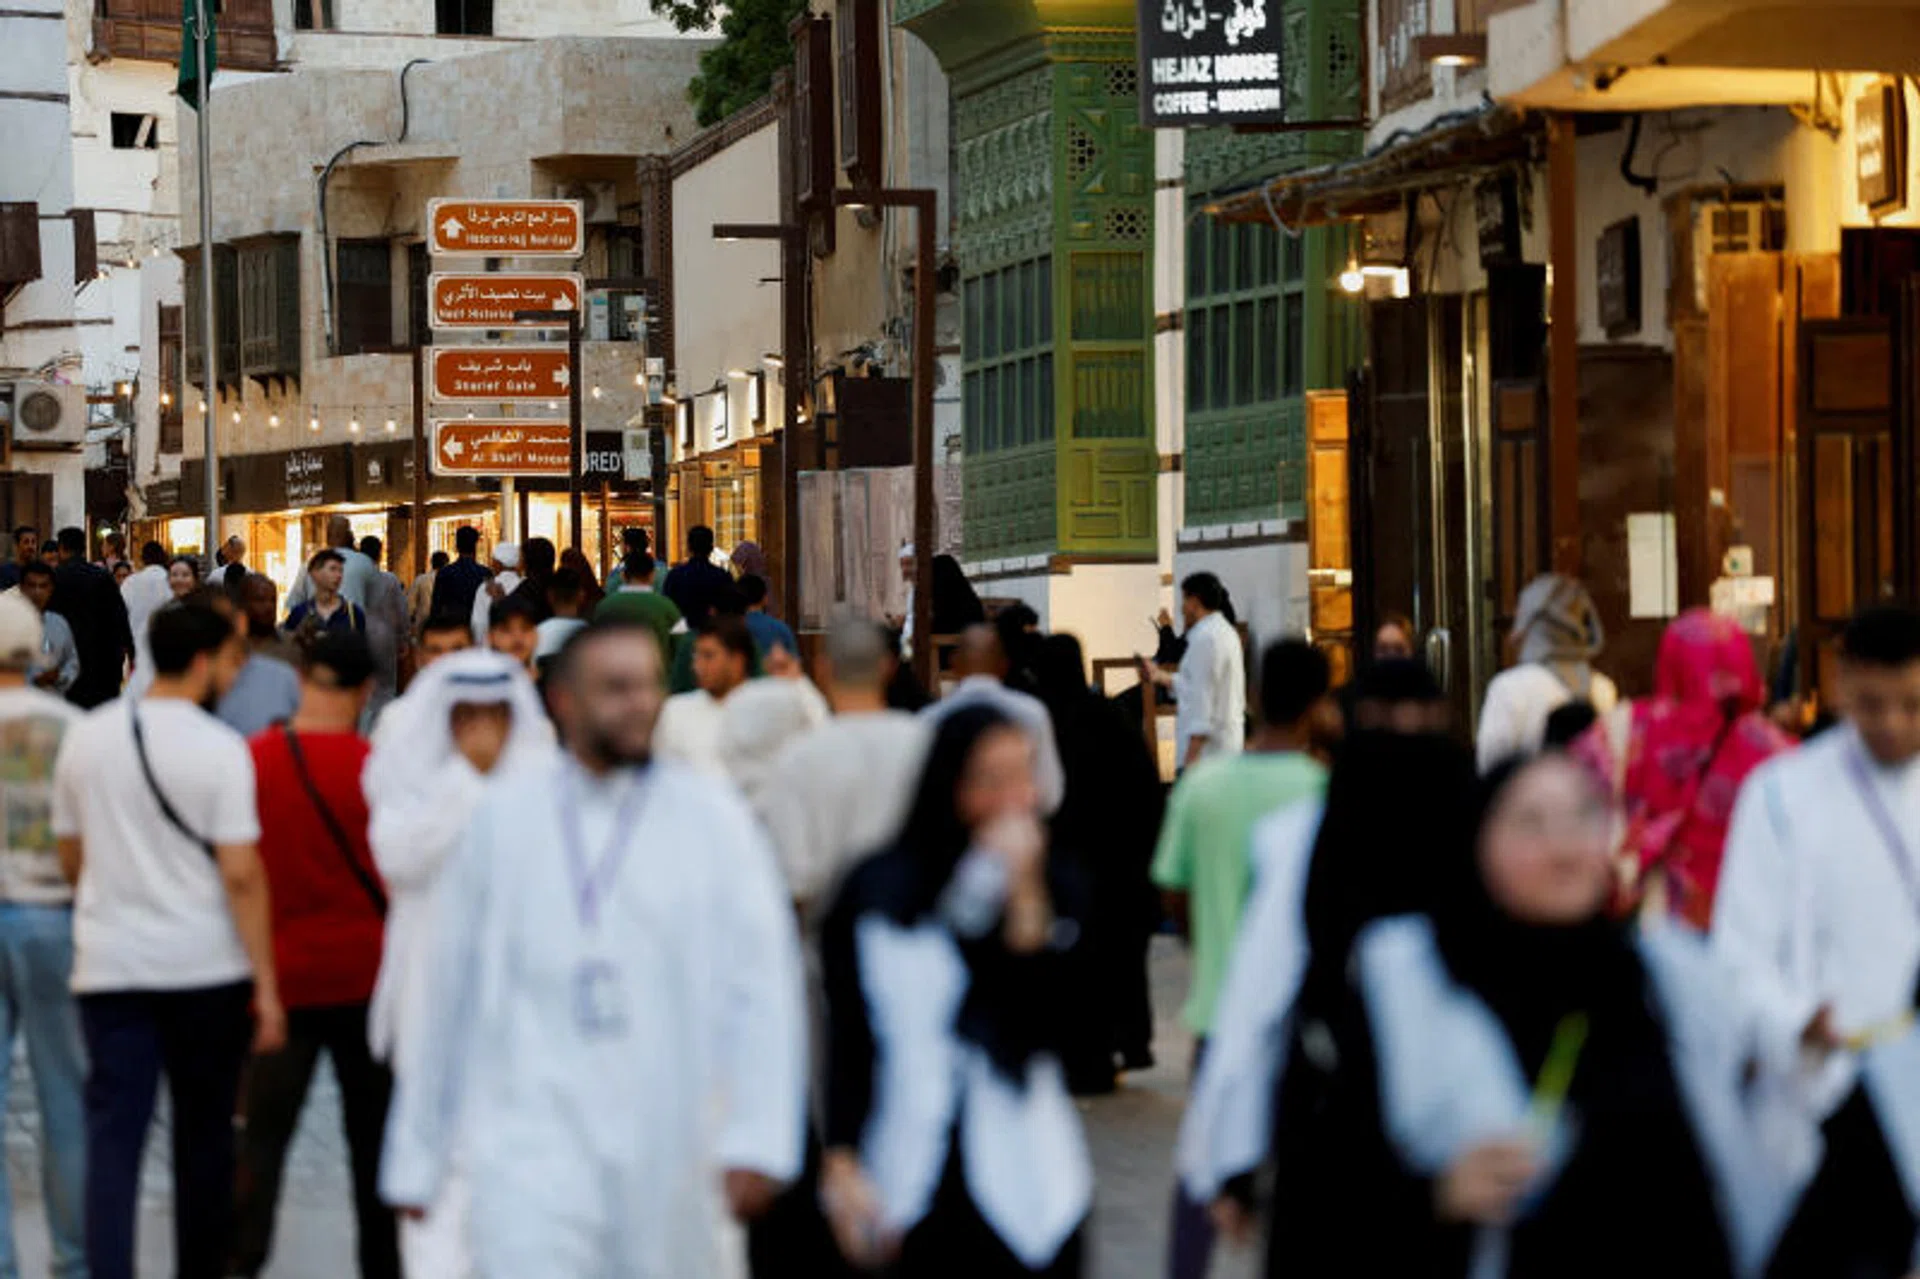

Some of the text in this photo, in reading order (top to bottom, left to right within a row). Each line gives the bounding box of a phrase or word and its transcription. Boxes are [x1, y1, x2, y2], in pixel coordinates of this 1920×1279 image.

[1152, 55, 1212, 84] HEJAZ
[1154, 91, 1208, 114] COFFEE
[480, 287, 519, 303] نصيف
[521, 288, 546, 303] بيت
[457, 357, 532, 375] باب شريف
[506, 380, 537, 392] Gate
